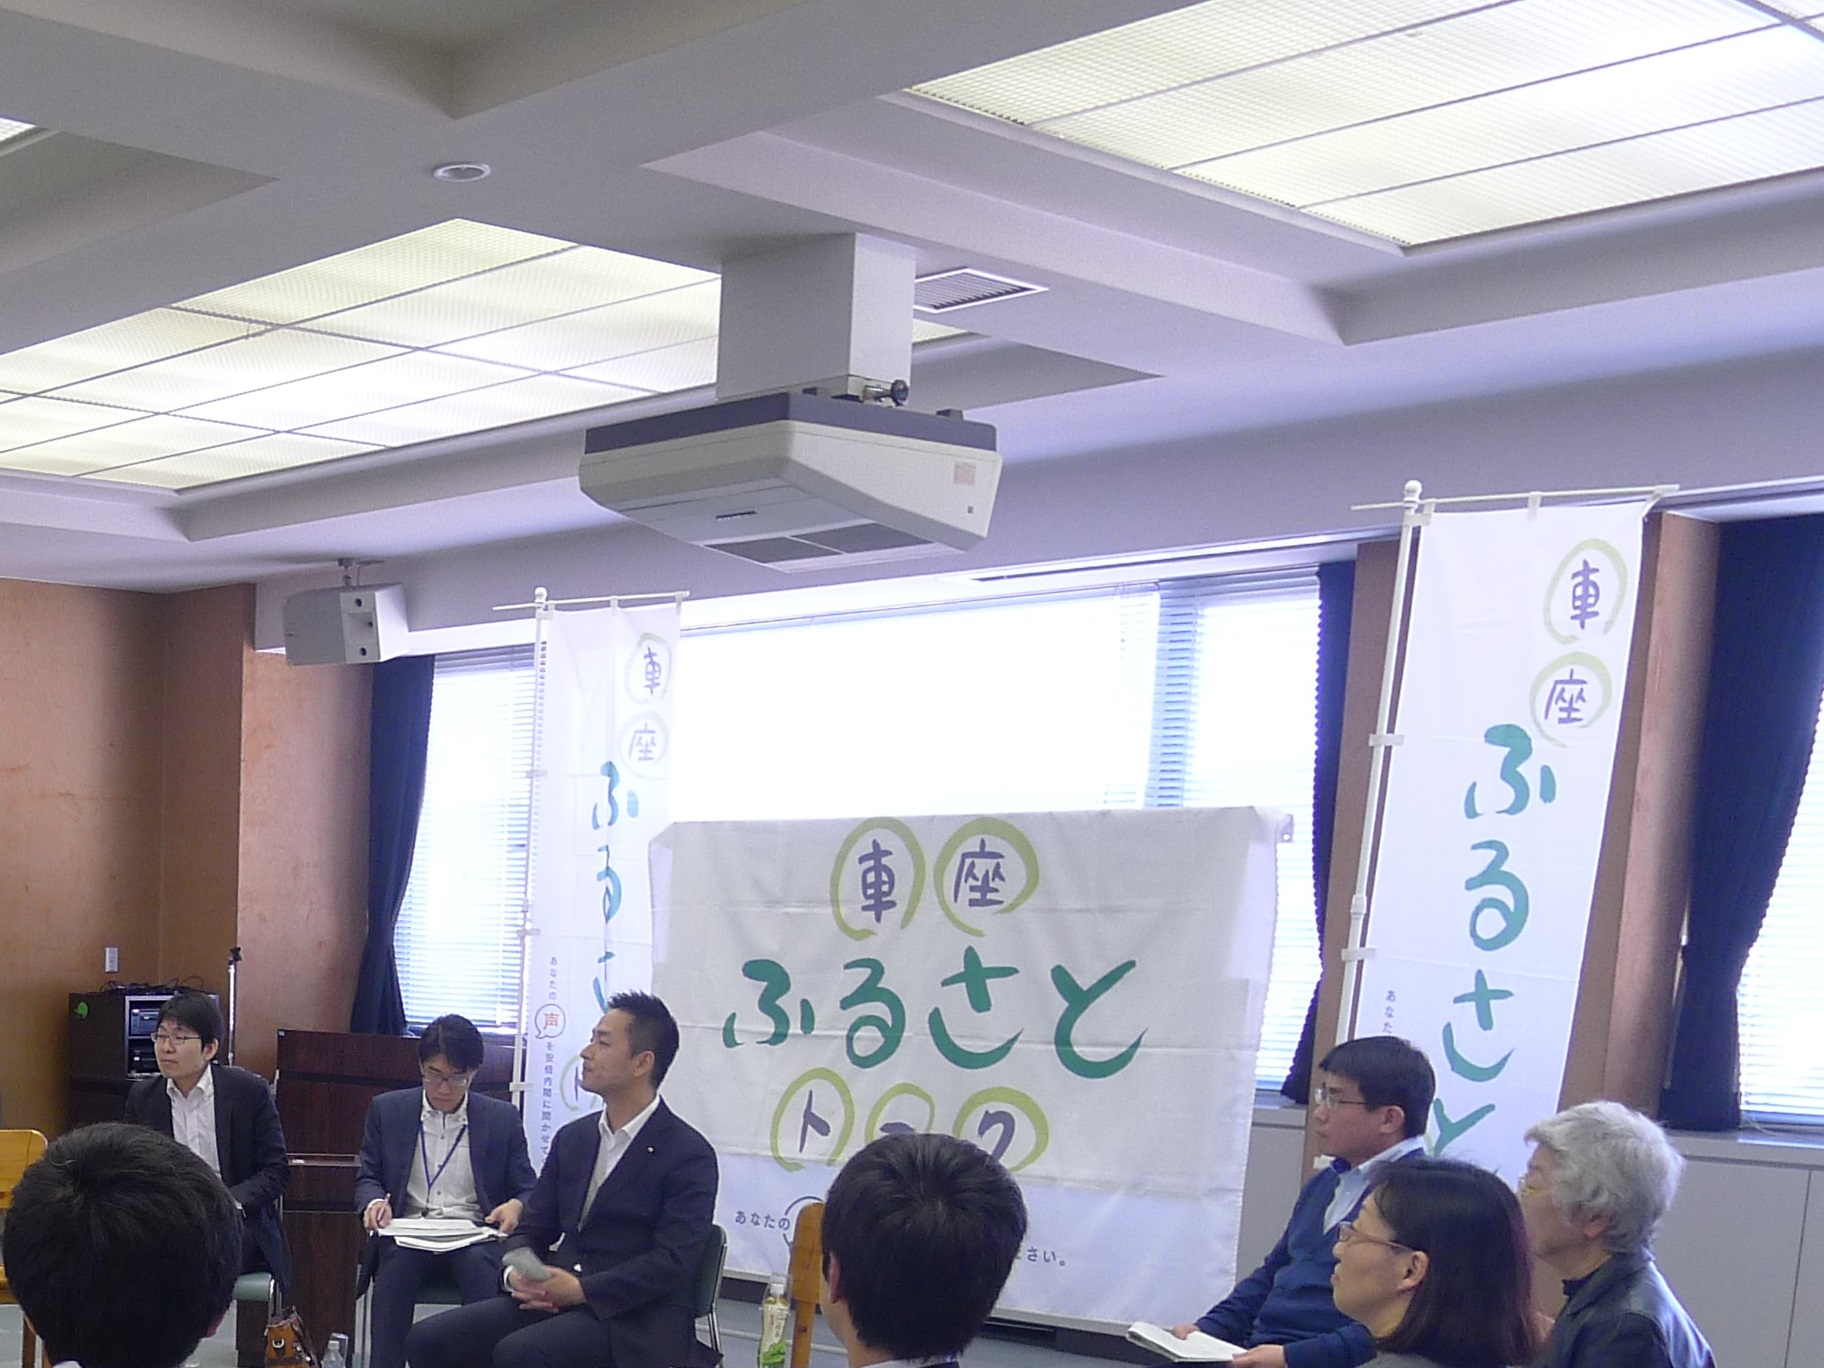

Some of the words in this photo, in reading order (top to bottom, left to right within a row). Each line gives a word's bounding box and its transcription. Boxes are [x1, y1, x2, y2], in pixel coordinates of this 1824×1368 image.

[1544, 559, 1602, 725] 車座
[858, 838, 1006, 923] 車座
[722, 945, 1149, 1079] ふるさと
[735, 1210, 791, 1231] あなたの
[1016, 1246, 1066, 1267] さい。
